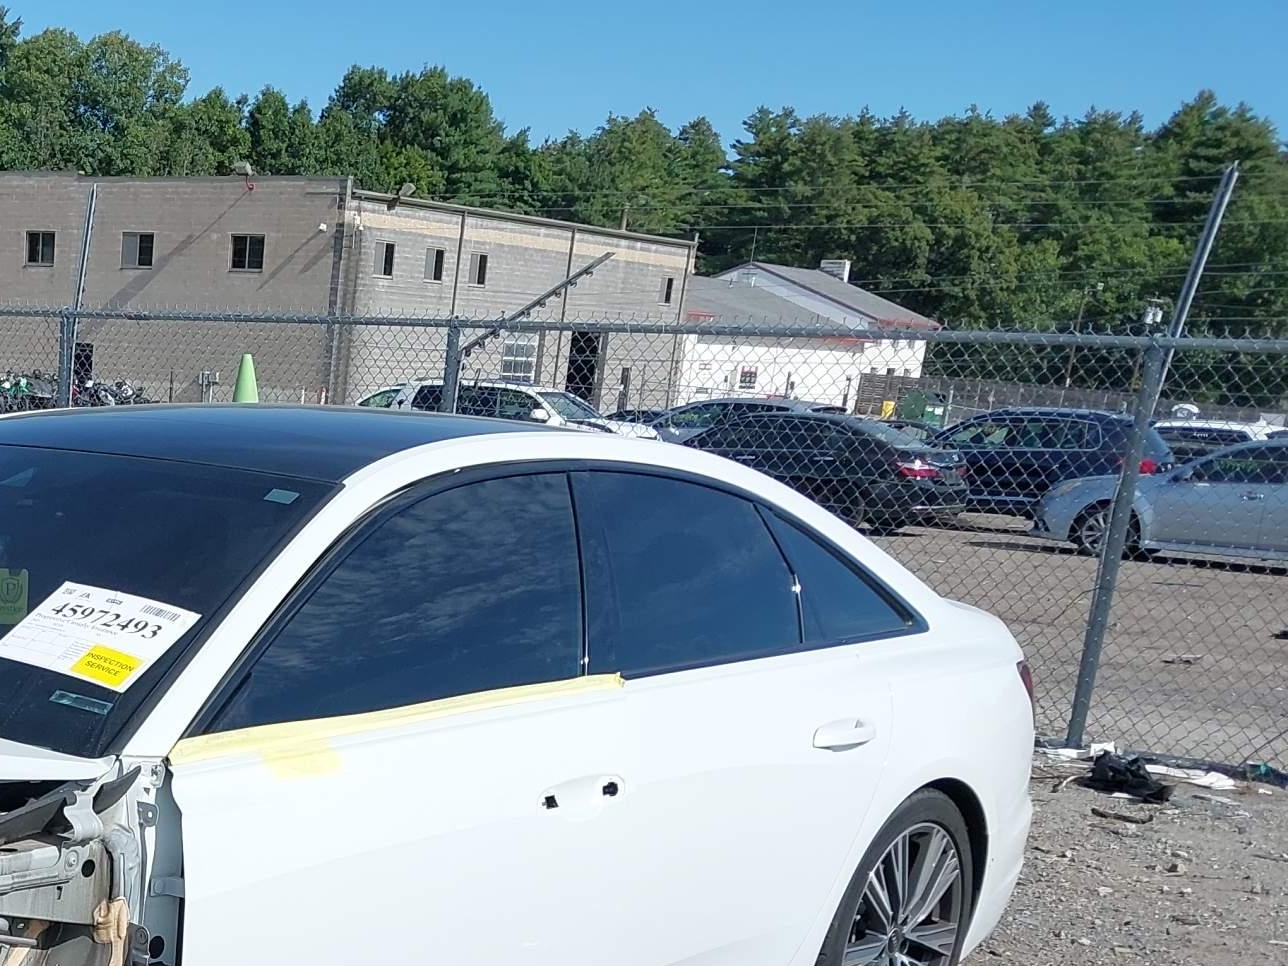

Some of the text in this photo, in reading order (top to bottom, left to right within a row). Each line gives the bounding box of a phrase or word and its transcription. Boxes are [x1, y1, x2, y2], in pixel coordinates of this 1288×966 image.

[51, 602, 163, 640] 45972493
[85, 660, 120, 677] SERVICE
[86, 652, 135, 672] INSPECTION
